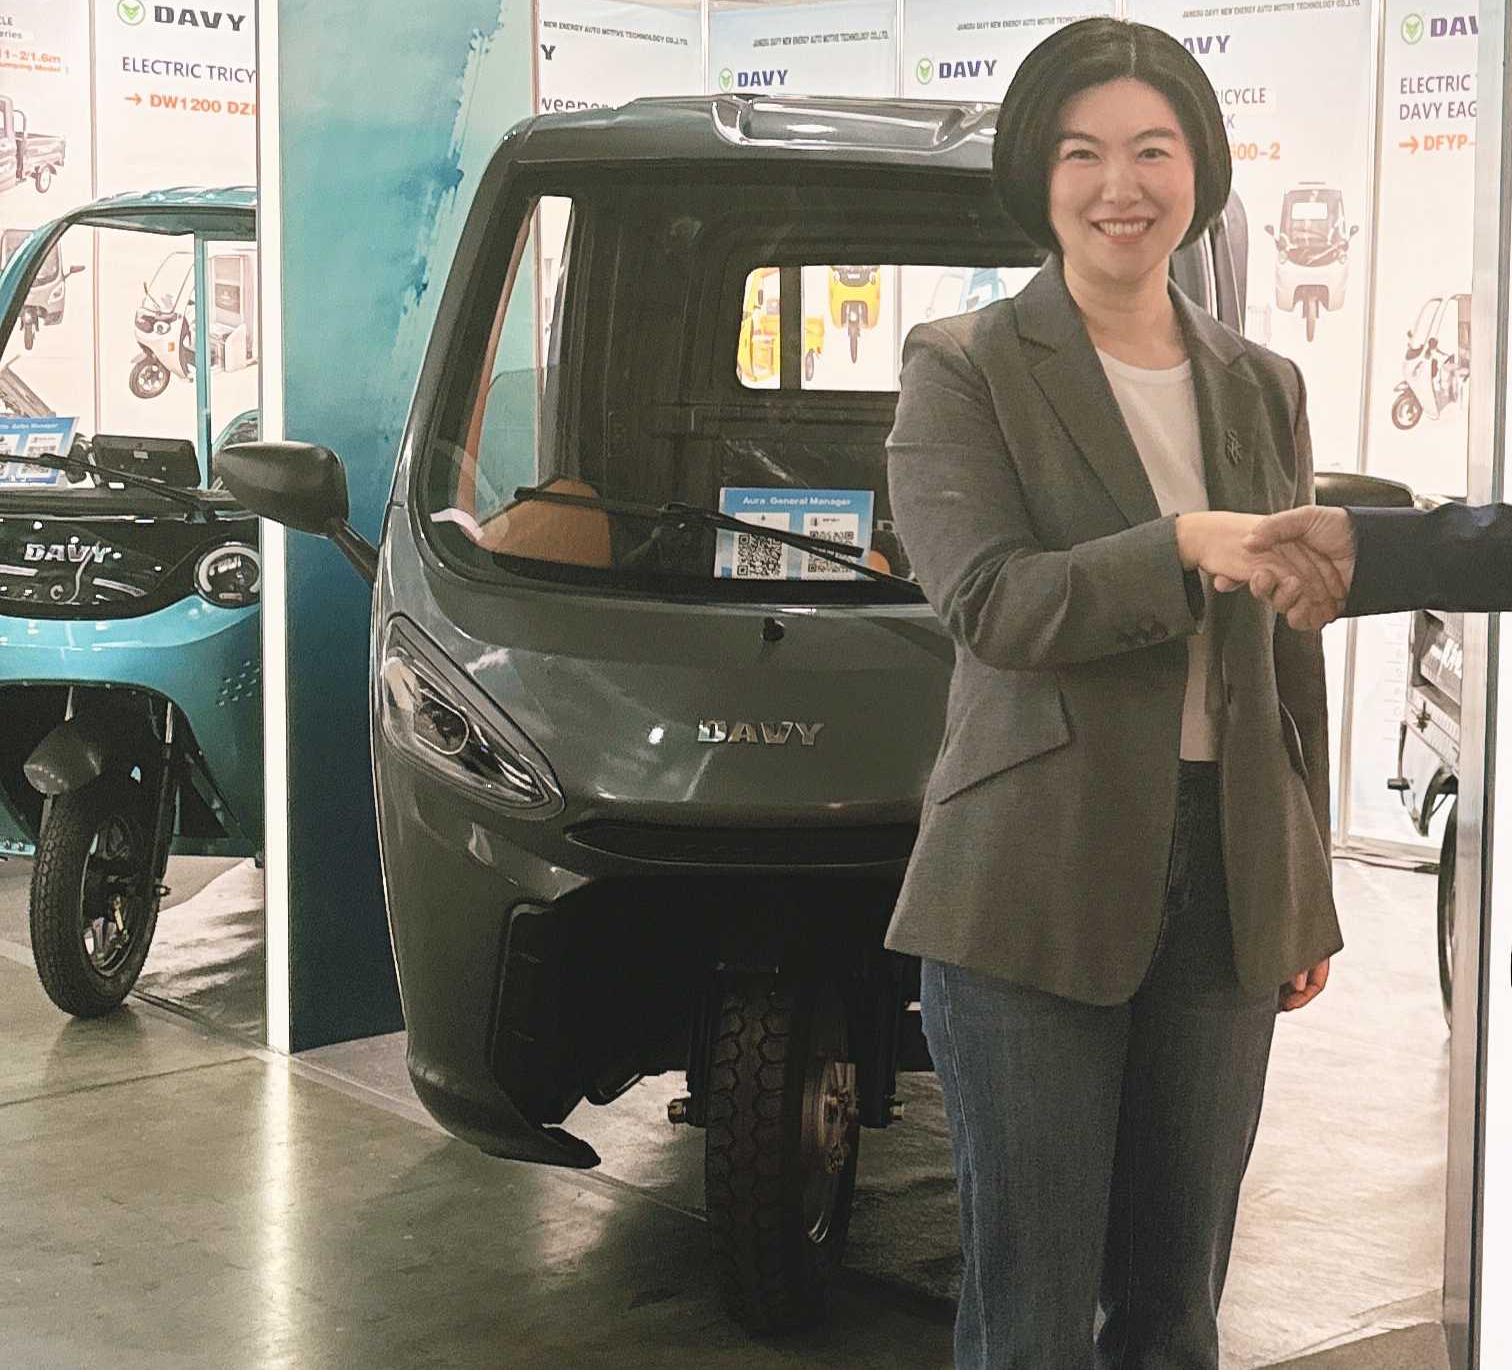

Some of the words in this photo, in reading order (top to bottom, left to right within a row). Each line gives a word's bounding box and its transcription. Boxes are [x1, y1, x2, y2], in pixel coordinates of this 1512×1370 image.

[154, 5, 246, 32] DAVY
[122, 56, 202, 79] ELECTRIC
[939, 60, 998, 79] DAVY
[737, 70, 789, 87] DAVY
[1400, 74, 1471, 94] ELECTRIC
[150, 94, 222, 114] DW1200
[1400, 102, 1442, 120] DAVY
[24, 543, 112, 563] DAVY
[697, 720, 825, 745] DAVY
